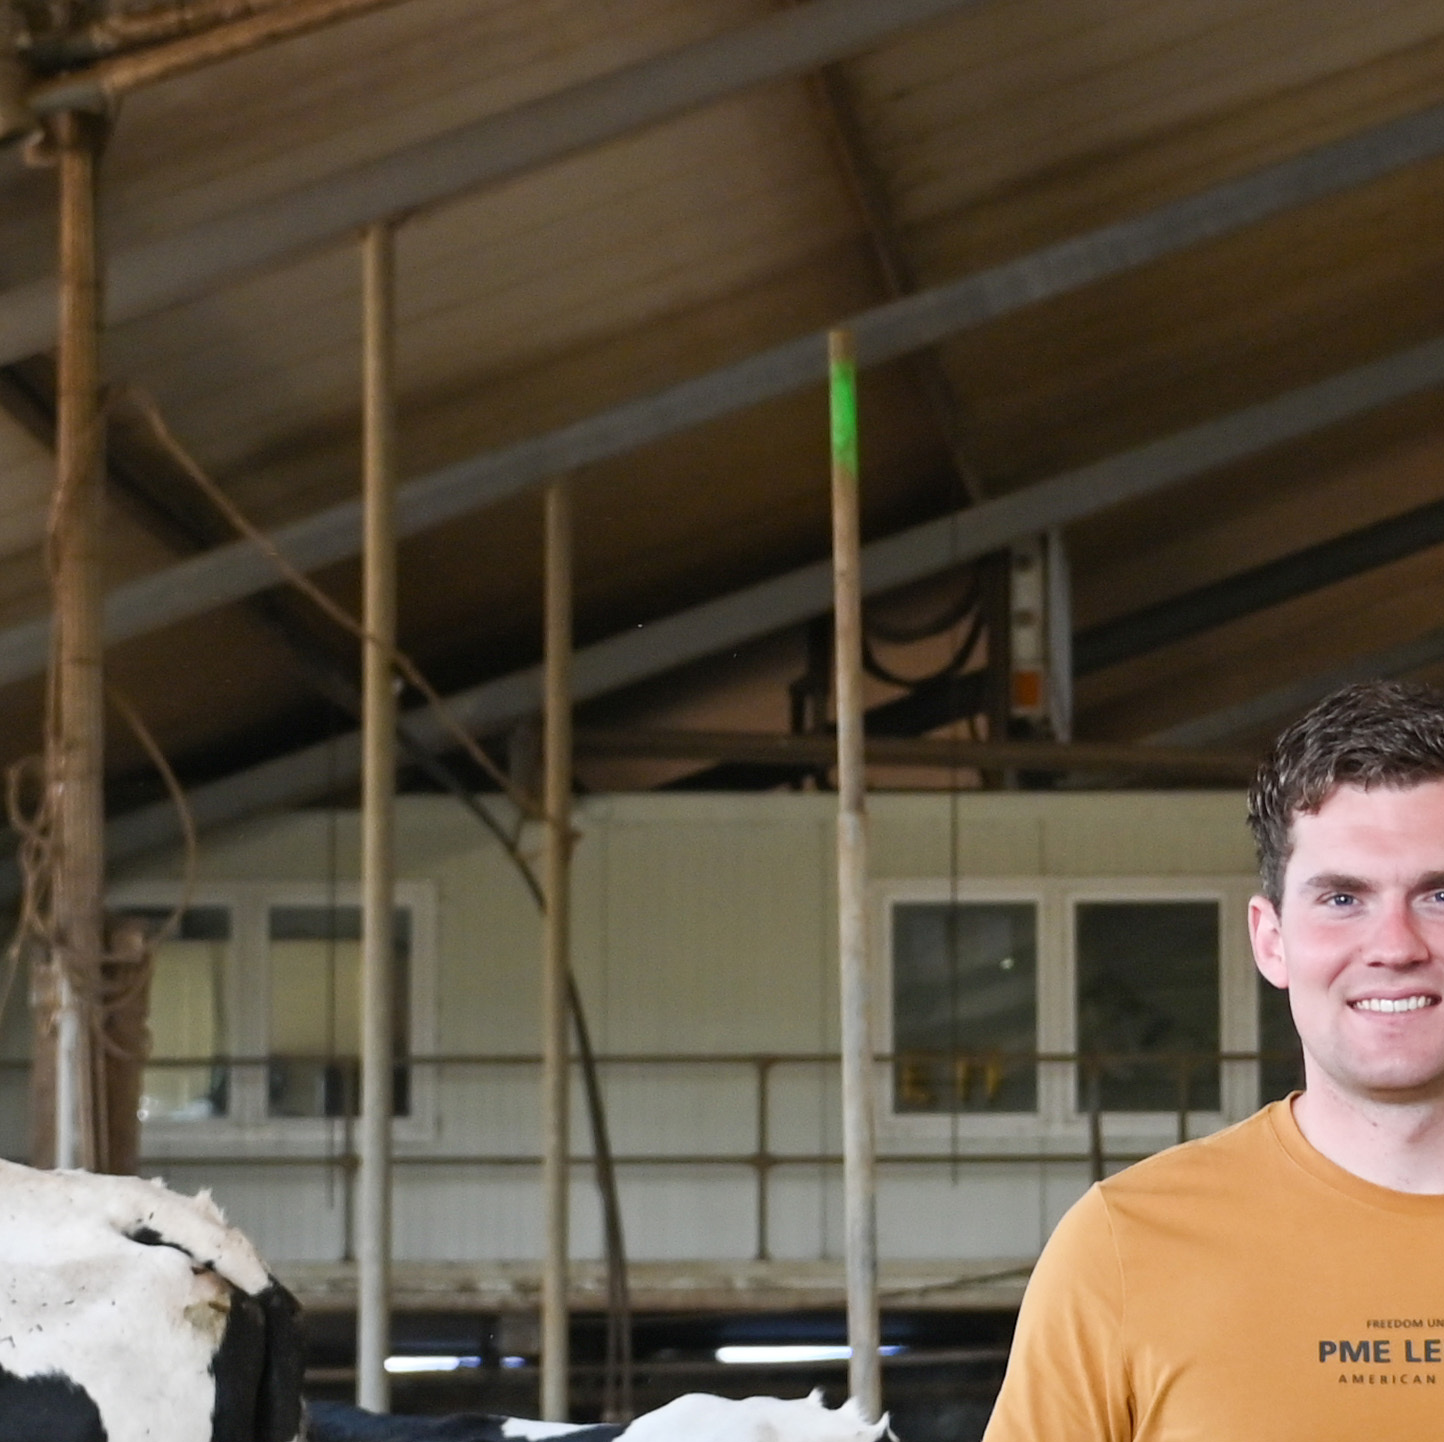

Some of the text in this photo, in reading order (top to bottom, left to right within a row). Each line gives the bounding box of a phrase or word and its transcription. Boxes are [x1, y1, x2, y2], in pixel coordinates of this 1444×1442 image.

[1366, 1318, 1424, 1330] FREEDOM
[1318, 1339, 1391, 1364] PME
[1338, 1374, 1437, 1386] AMERICAN
